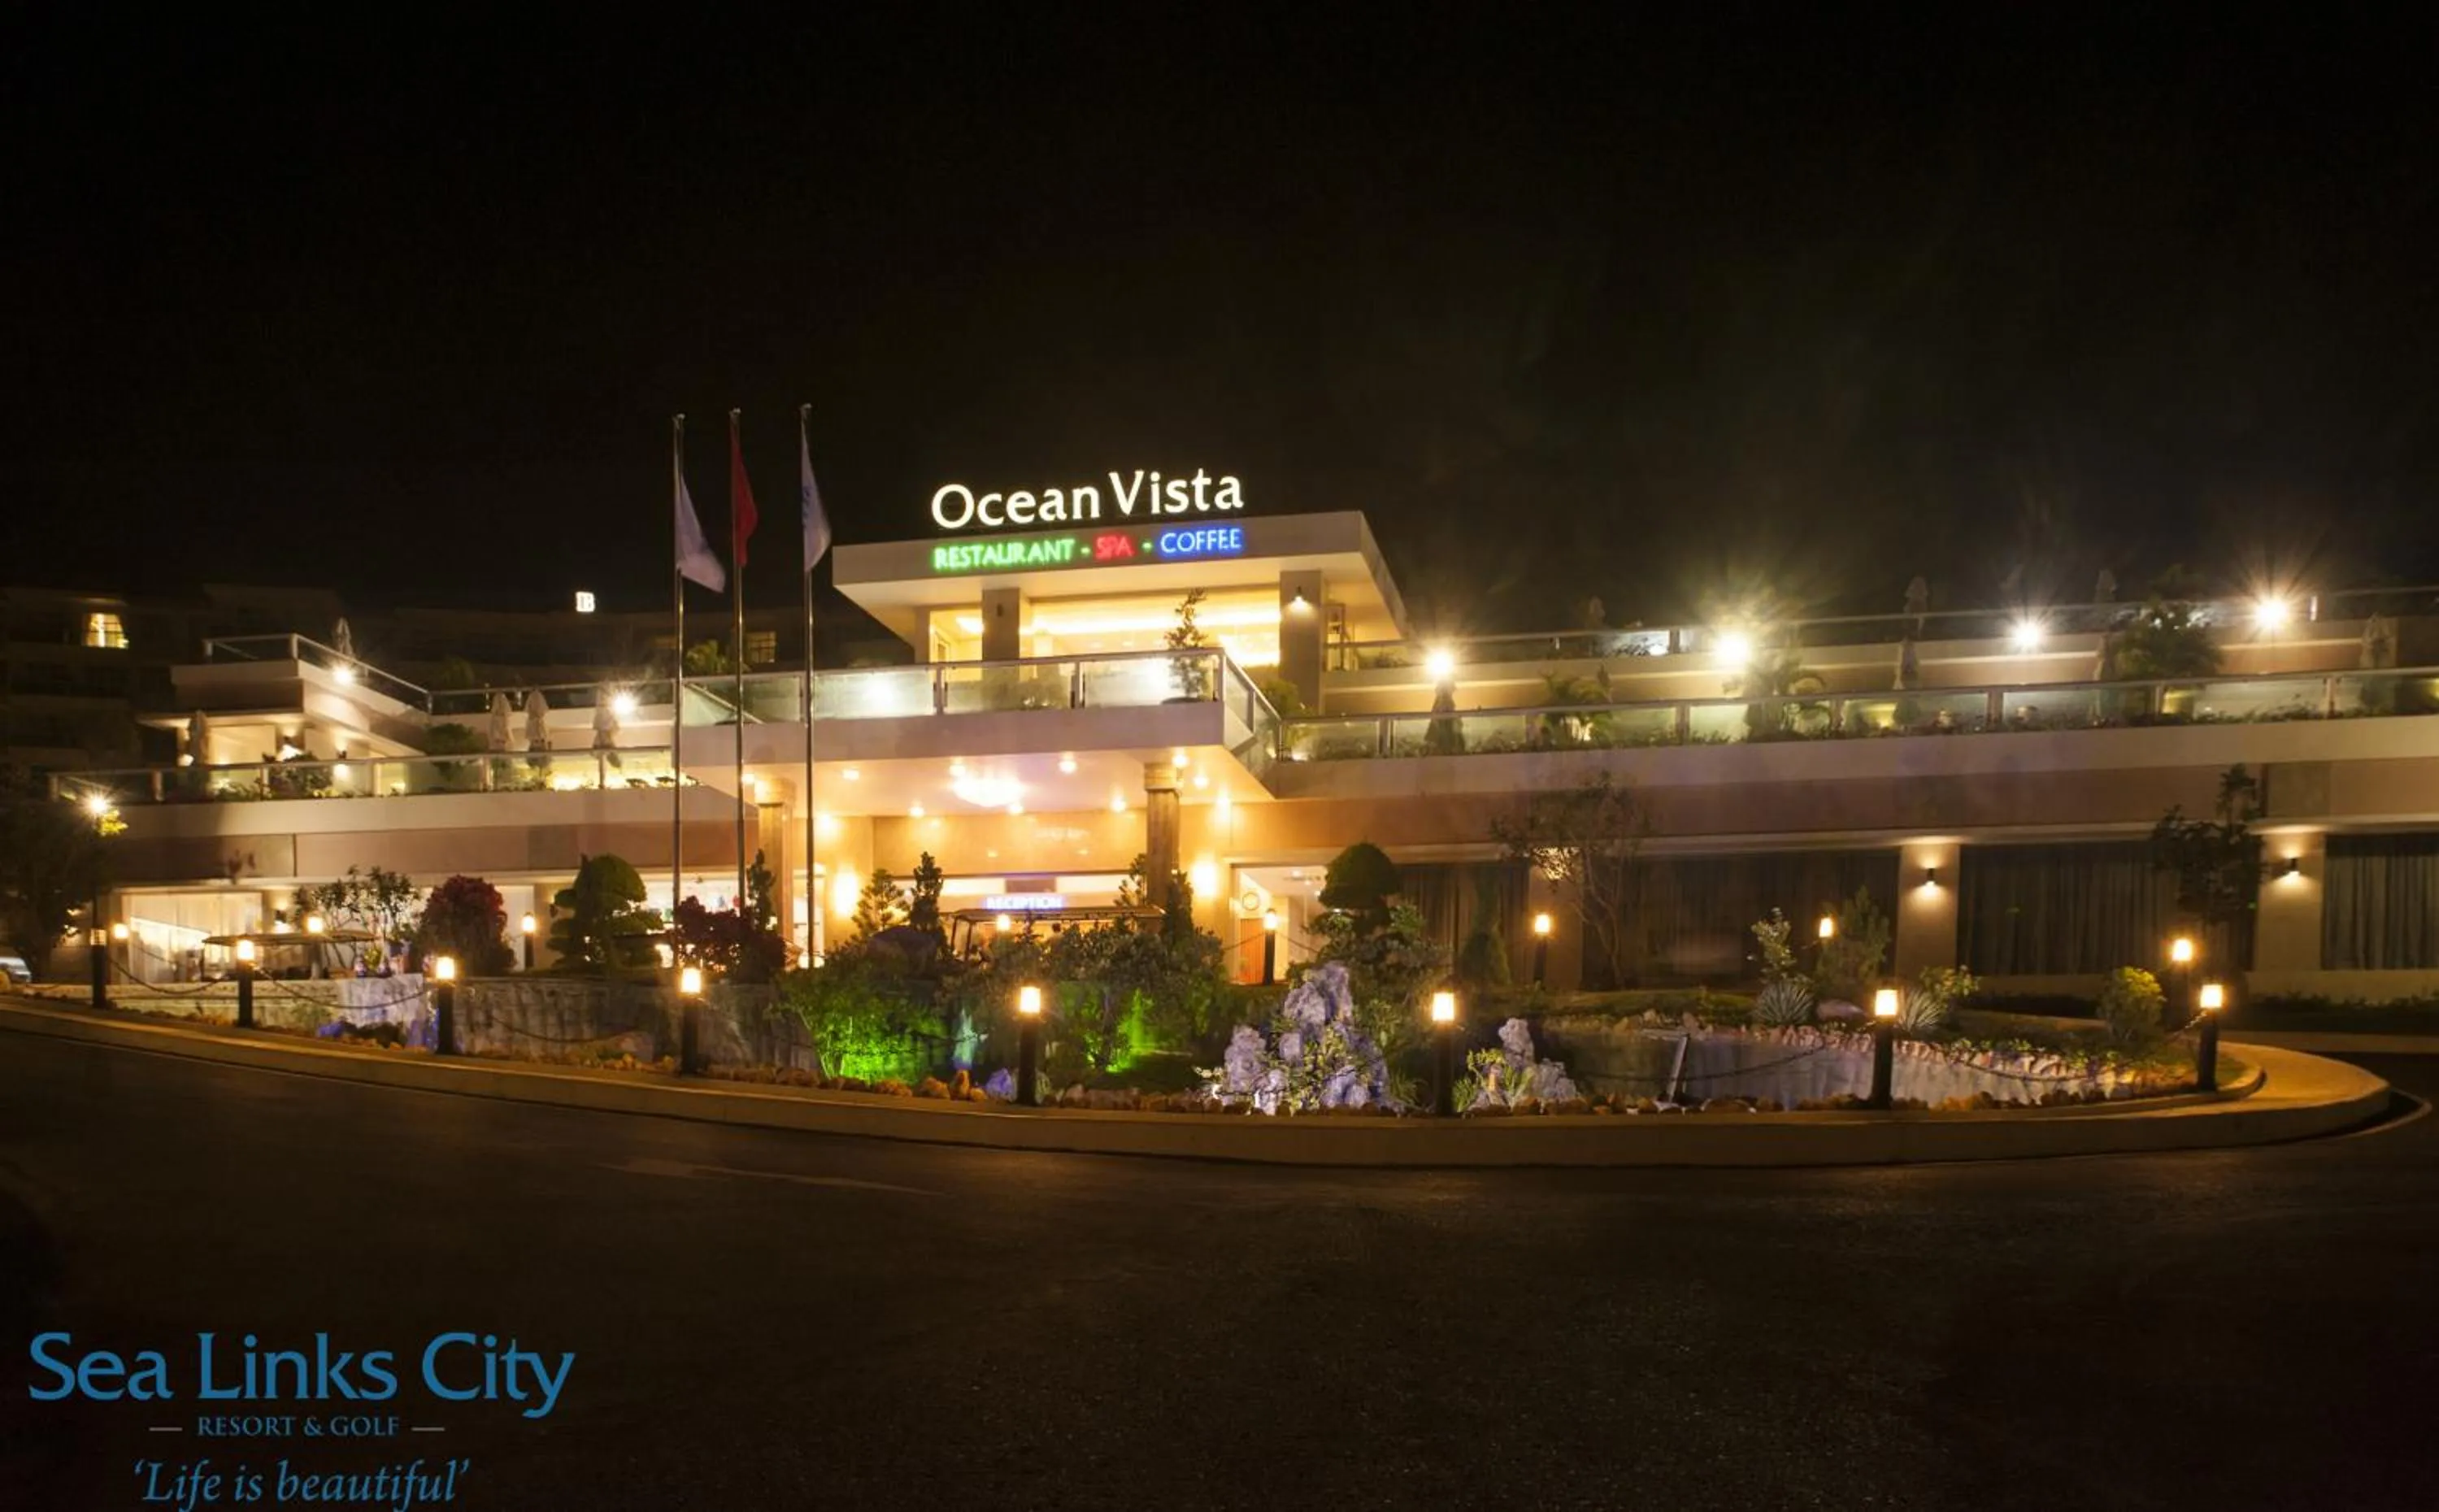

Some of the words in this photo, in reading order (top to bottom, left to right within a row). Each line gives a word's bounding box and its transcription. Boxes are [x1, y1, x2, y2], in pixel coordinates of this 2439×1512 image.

[931, 484, 1100, 529] Ocean
[1109, 467, 1245, 515] Vista
[933, 539, 1076, 571] RESTAURANT
[1095, 533, 1134, 560] SPA
[1159, 527, 1242, 554] COFFEE
